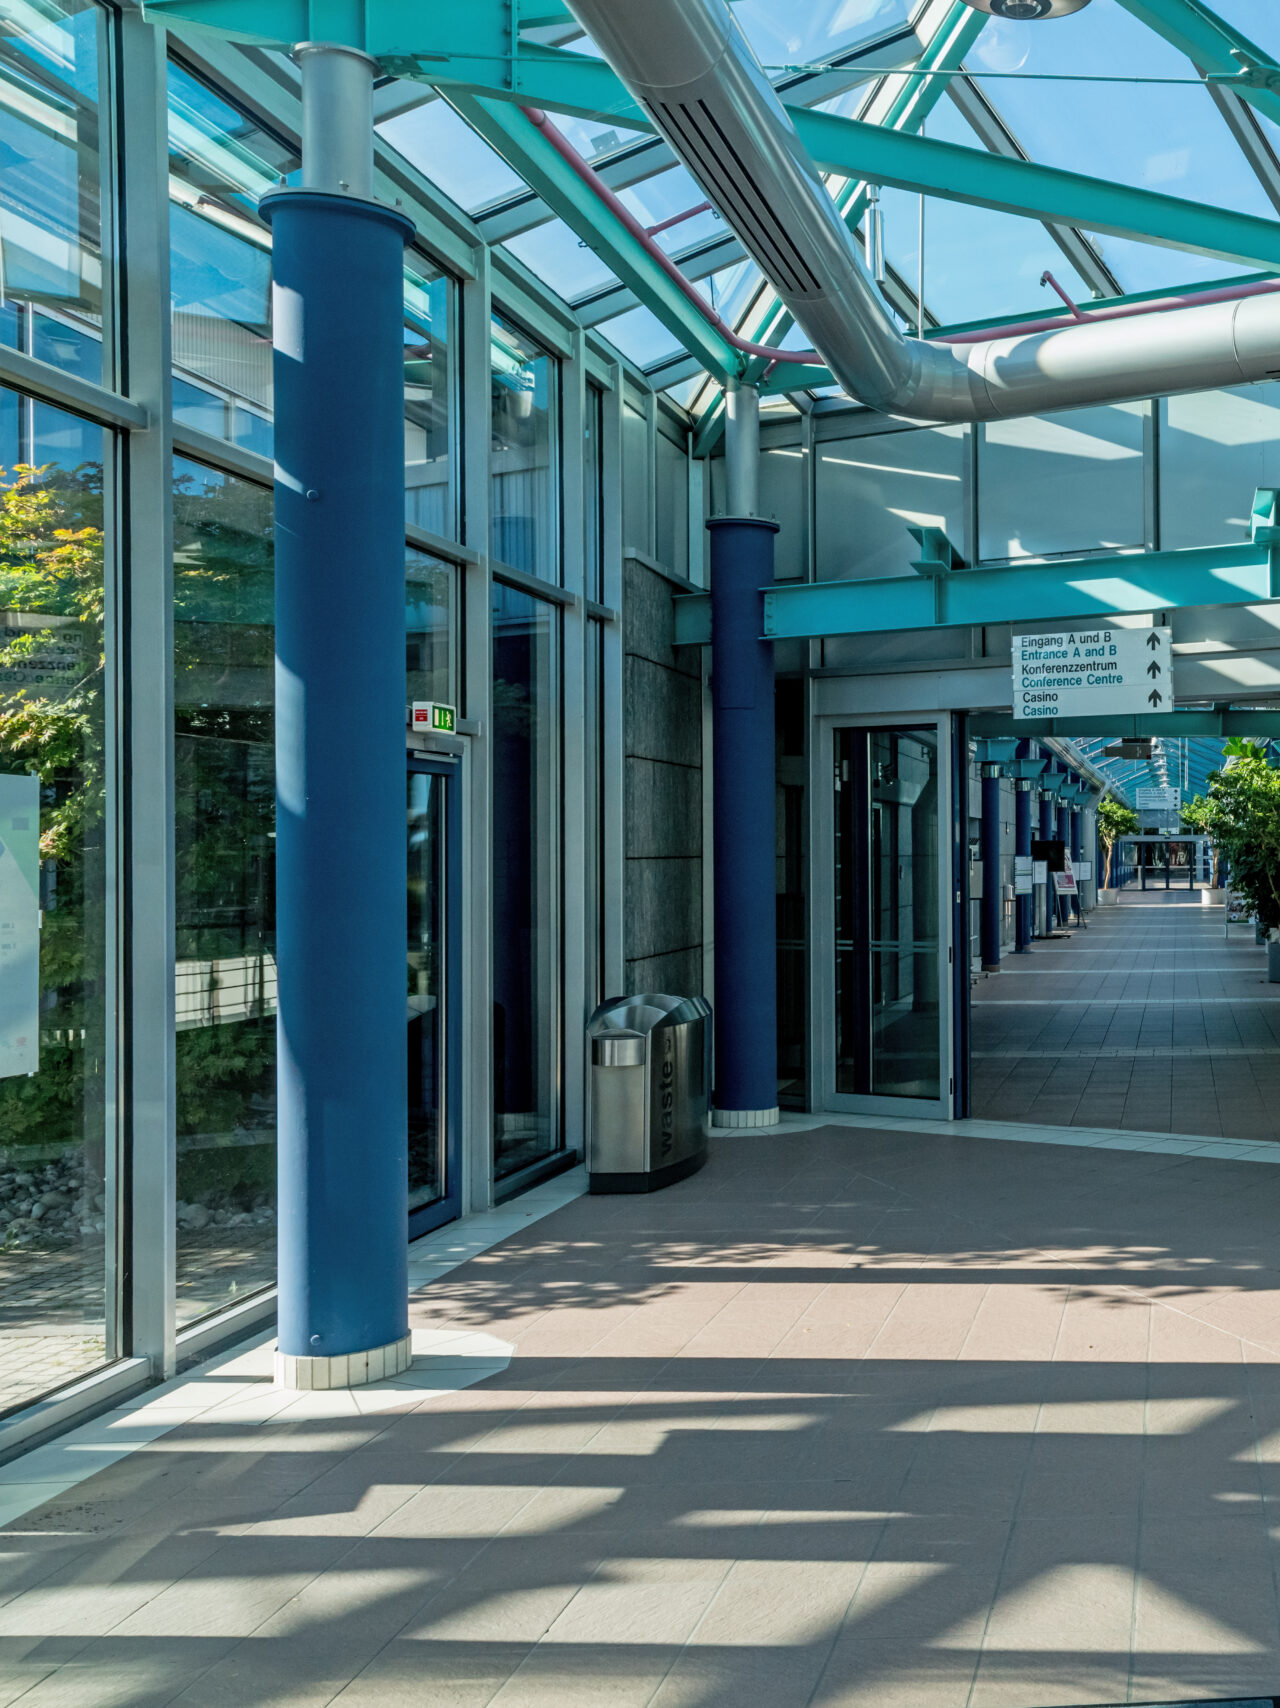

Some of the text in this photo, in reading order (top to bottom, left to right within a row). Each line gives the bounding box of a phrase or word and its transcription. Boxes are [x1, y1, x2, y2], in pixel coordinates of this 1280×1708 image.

[1021, 631, 1112, 649] Eingang A und B
[1021, 644, 1117, 661] Entrance A and B
[1021, 660, 1118, 675] Konferenzzentrum
[1021, 673, 1123, 688] Conference Centre
[1022, 691, 1059, 704] Casino
[1022, 704, 1059, 717] Casino
[660, 1061, 673, 1158] waste
